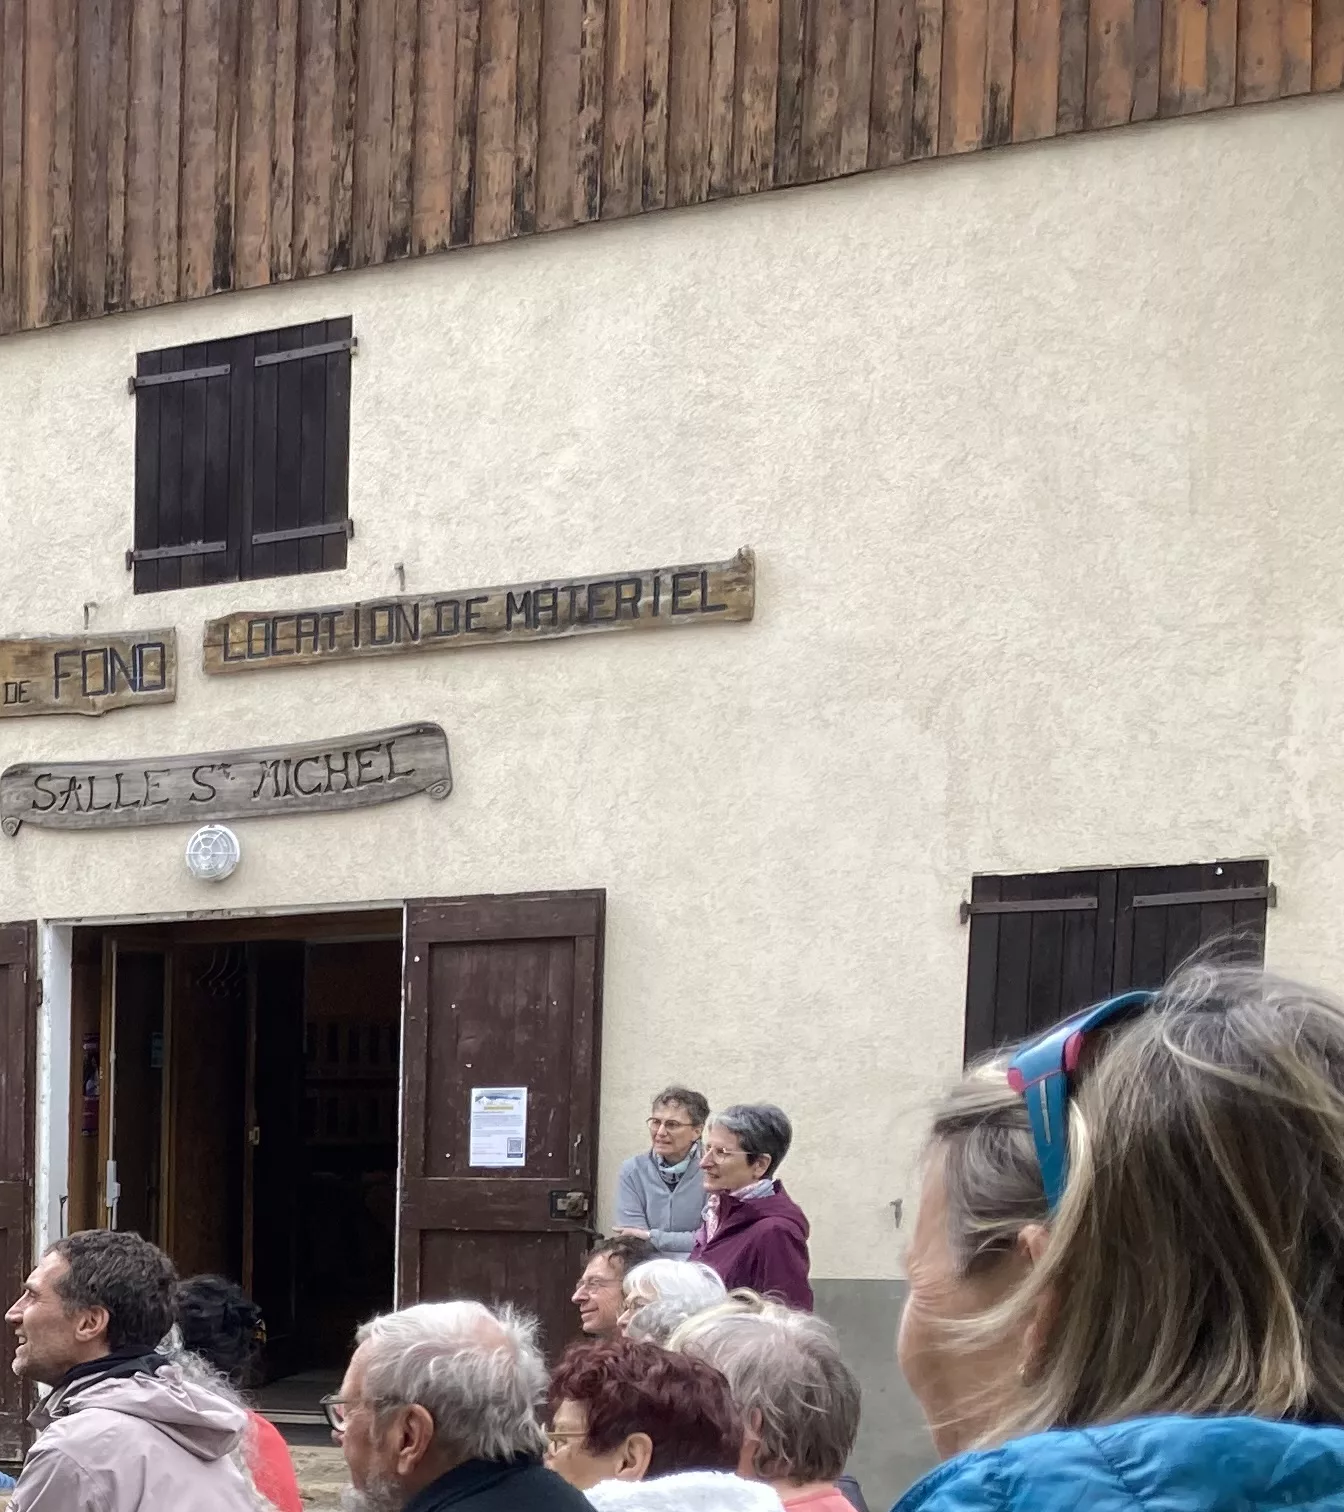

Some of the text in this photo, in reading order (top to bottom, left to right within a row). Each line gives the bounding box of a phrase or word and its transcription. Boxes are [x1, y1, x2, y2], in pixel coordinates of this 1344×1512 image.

[434, 596, 489, 636] DE
[505, 568, 728, 631] MATERIEL
[4, 680, 31, 706] DE
[54, 641, 166, 700] FOND
[32, 768, 171, 813] SALLE
[251, 740, 416, 801] MICHEL
